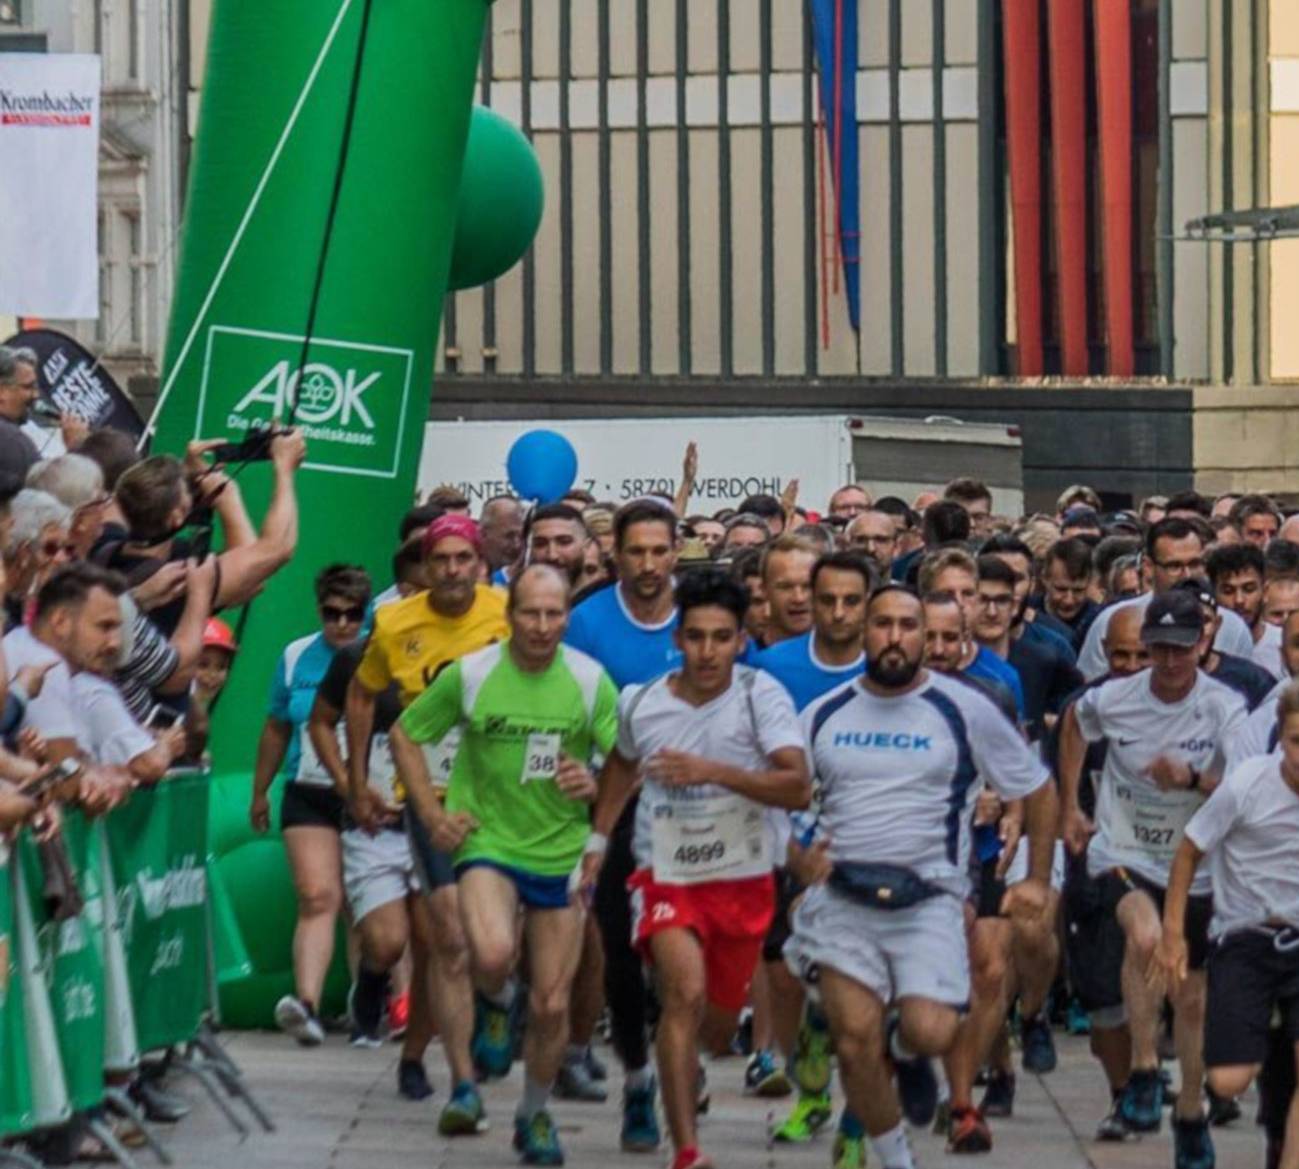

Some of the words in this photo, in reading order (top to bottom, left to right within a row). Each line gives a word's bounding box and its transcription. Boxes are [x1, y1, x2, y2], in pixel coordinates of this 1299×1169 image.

[233, 359, 383, 429] AOK
[834, 731, 932, 750] HUECK
[674, 840, 725, 864] 4899
